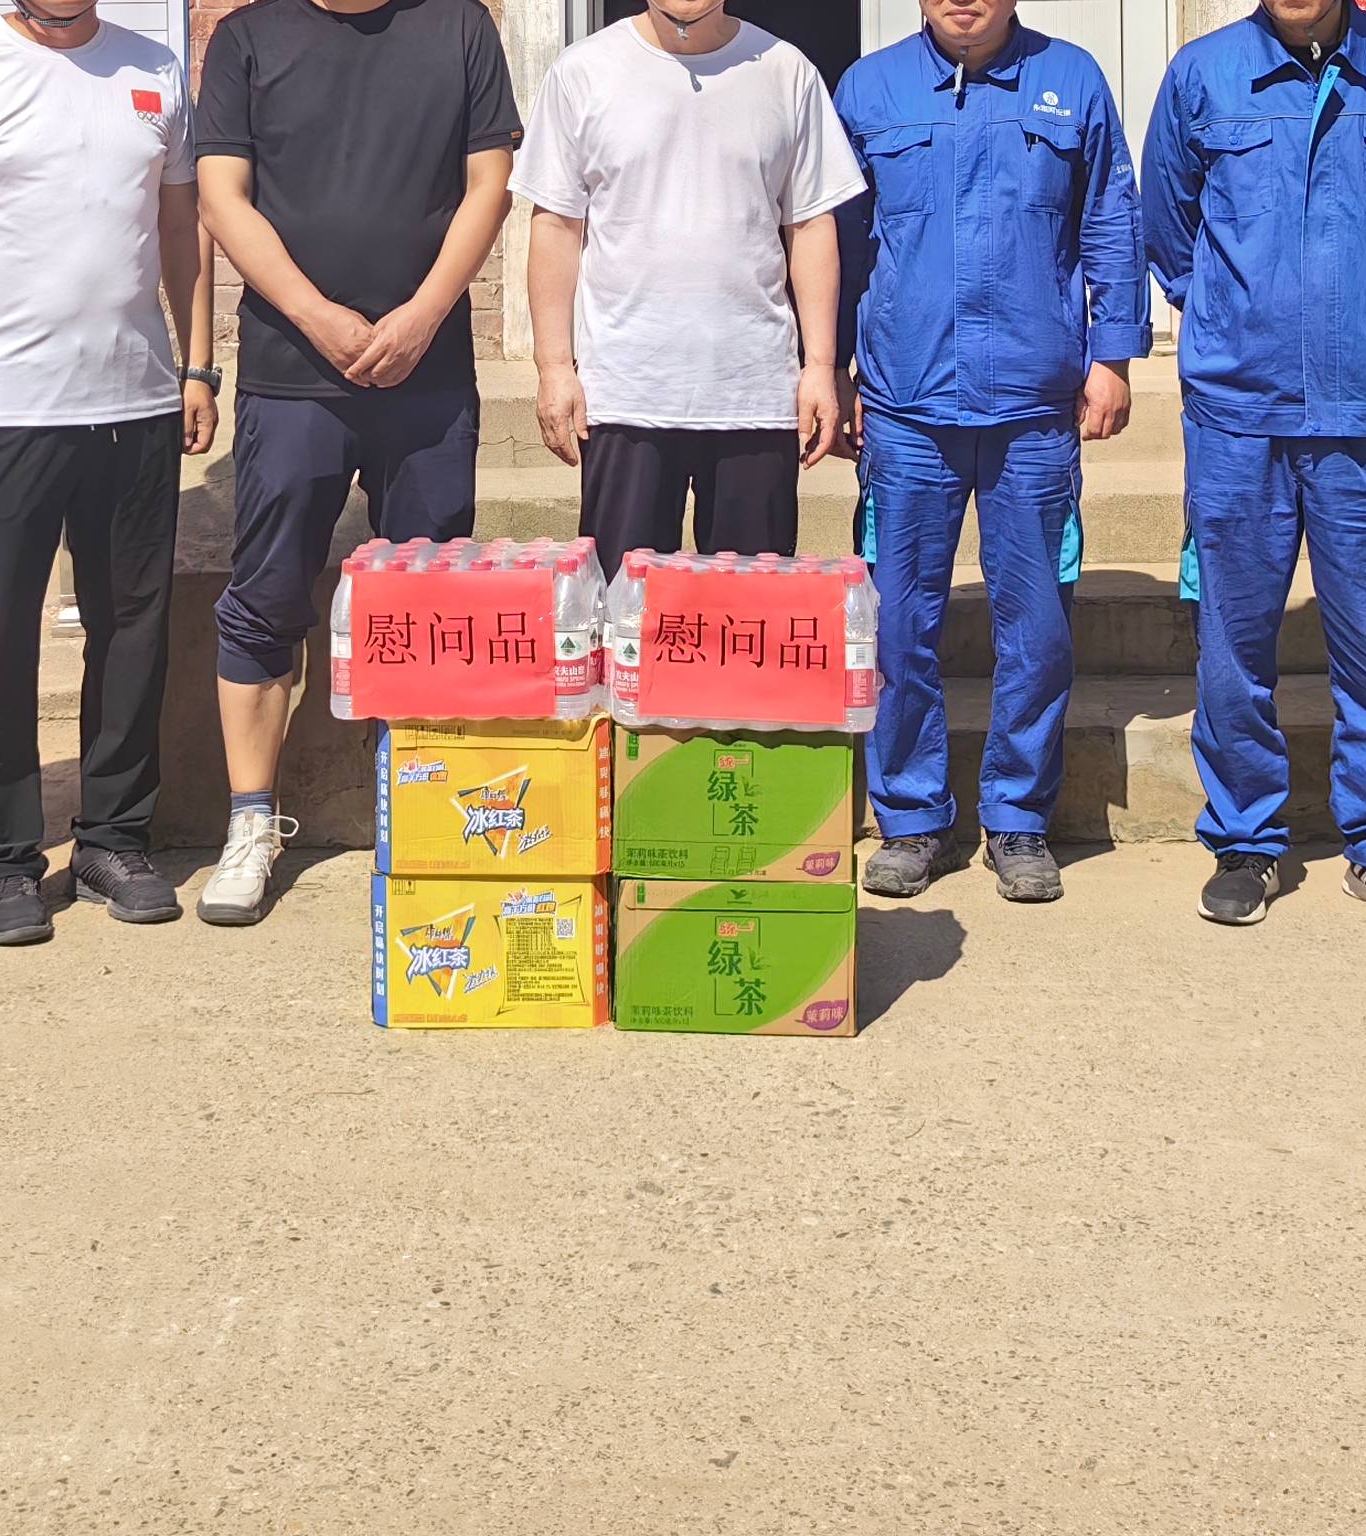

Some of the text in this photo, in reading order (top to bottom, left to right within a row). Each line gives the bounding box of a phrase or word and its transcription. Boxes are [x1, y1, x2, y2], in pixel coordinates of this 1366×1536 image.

[364, 611, 536, 666] 慰问品
[653, 612, 828, 670] 慰问品
[464, 806, 524, 842] 冰红茶
[407, 945, 469, 984] 冰红茶
[807, 1007, 844, 1020] 茉莉味
